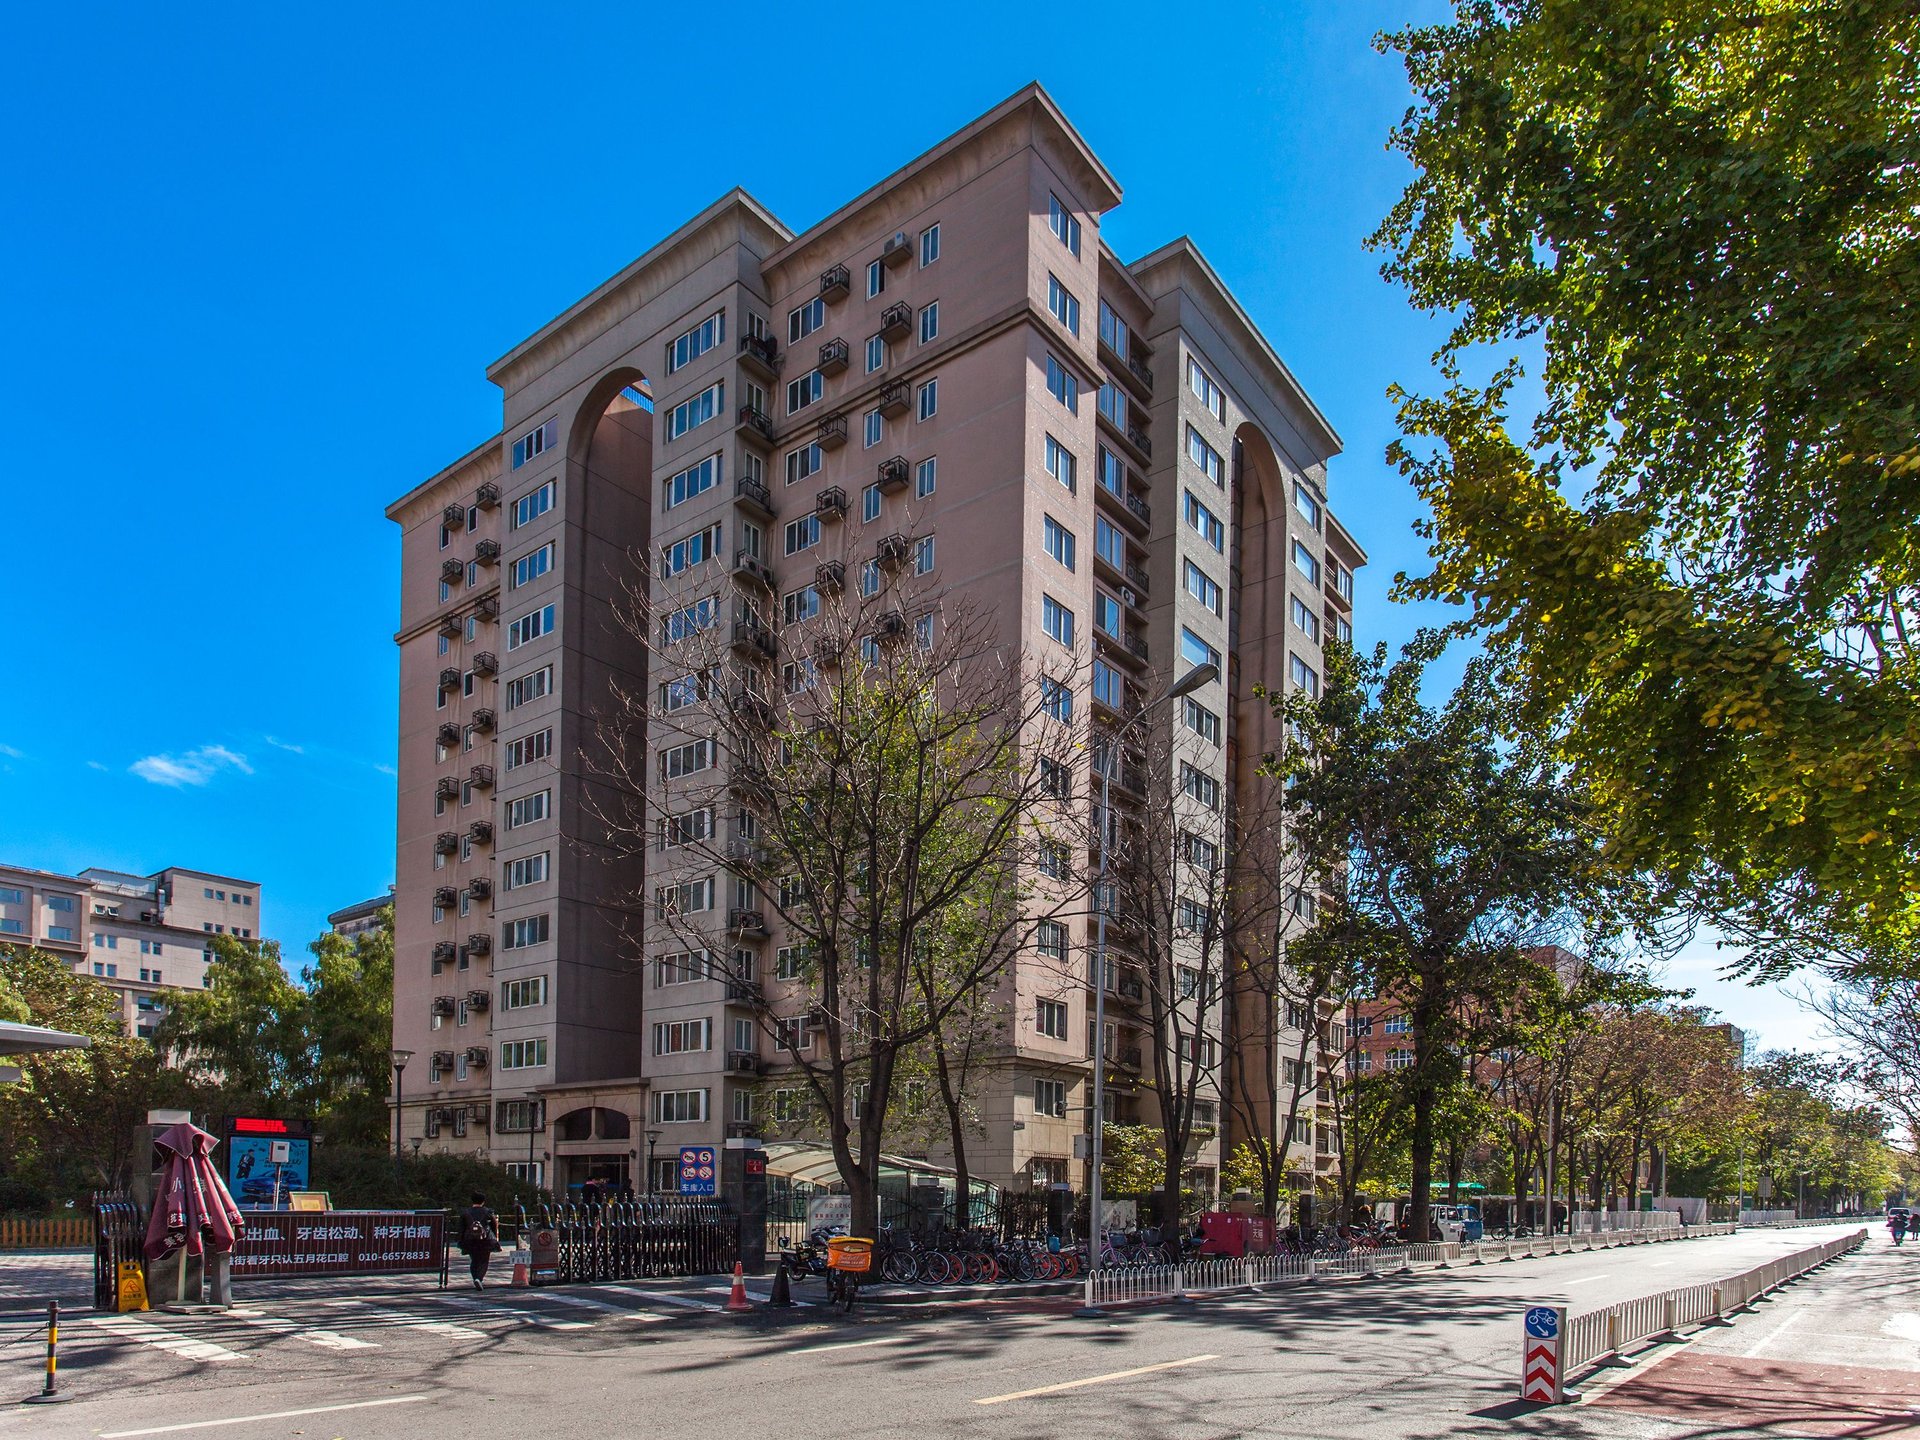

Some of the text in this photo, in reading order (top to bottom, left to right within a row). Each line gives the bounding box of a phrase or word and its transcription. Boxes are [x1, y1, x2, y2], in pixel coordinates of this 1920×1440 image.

[702, 1152, 709, 1162] 5
[681, 1183, 714, 1192] 车库入口
[358, 1251, 431, 1263] 010-66578833
